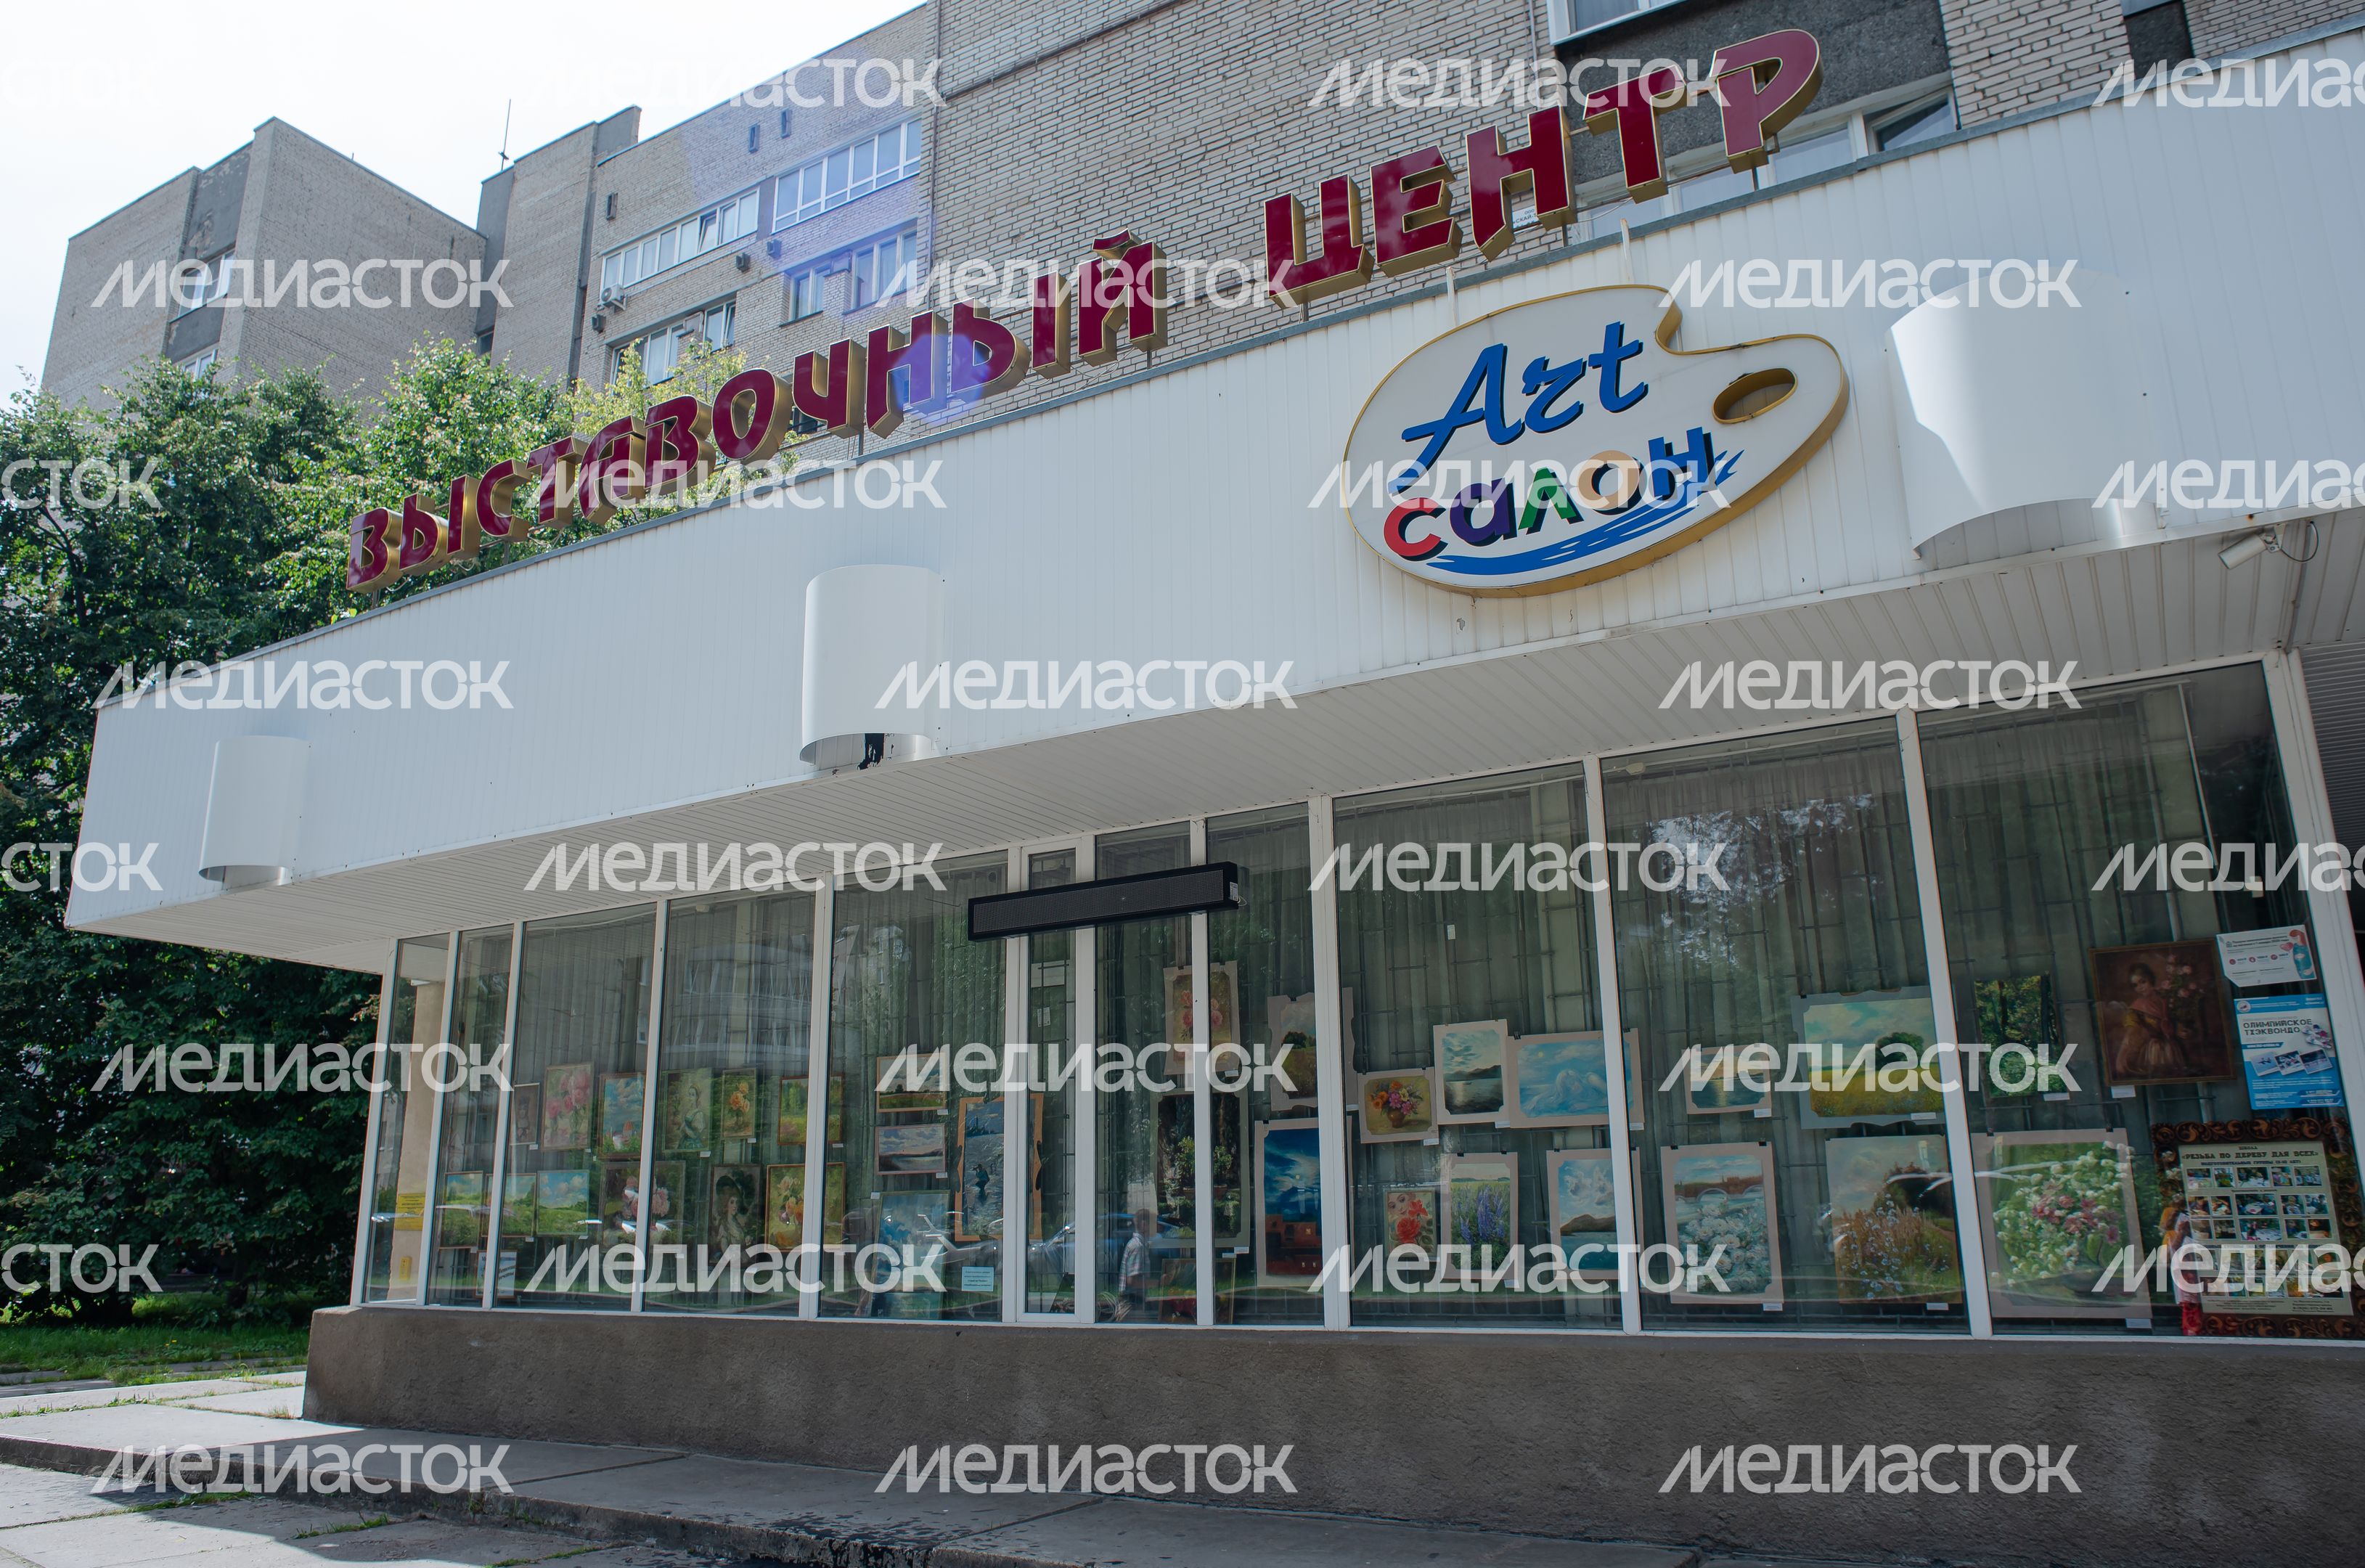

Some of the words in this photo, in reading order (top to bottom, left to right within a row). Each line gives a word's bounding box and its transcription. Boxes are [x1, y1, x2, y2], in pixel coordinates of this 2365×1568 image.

[346, 228, 1168, 593] ВЫСТАВОЧНЫЙ
[1264, 29, 1823, 309] ЦЕНТР
[2243, 1018, 2312, 1029] ОЛИМПИЙСКОЕ
